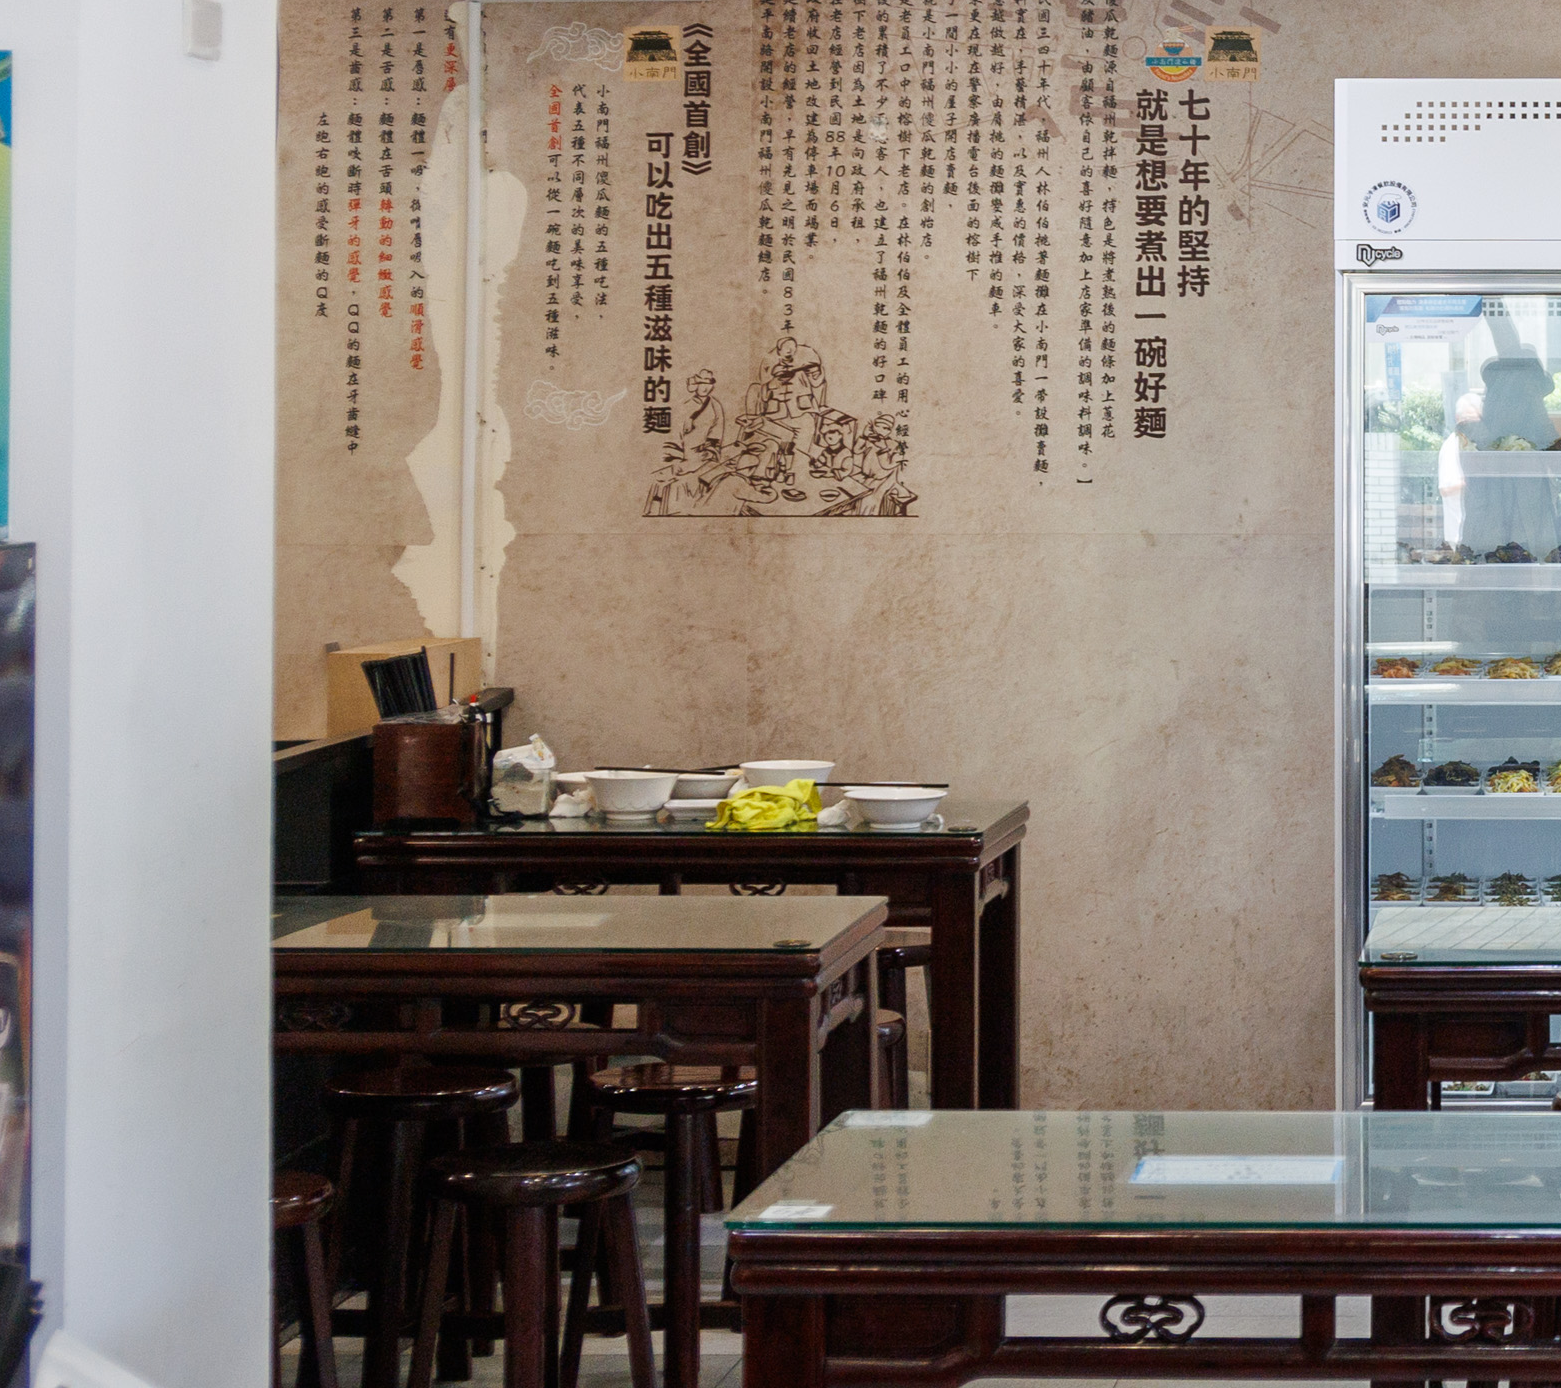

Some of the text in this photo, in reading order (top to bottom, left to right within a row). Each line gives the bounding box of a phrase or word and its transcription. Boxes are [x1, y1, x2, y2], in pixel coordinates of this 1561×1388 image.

[629, 66, 679, 80] 小南門
[681, 22, 714, 176] 《全國首創》
[1210, 66, 1258, 80] 小南門
[642, 131, 675, 434] 可以吃出五種滋味的麵
[1134, 89, 1169, 439] 就是想要煮出一碗好麵
[1178, 89, 1211, 298] 七十年的堅持
